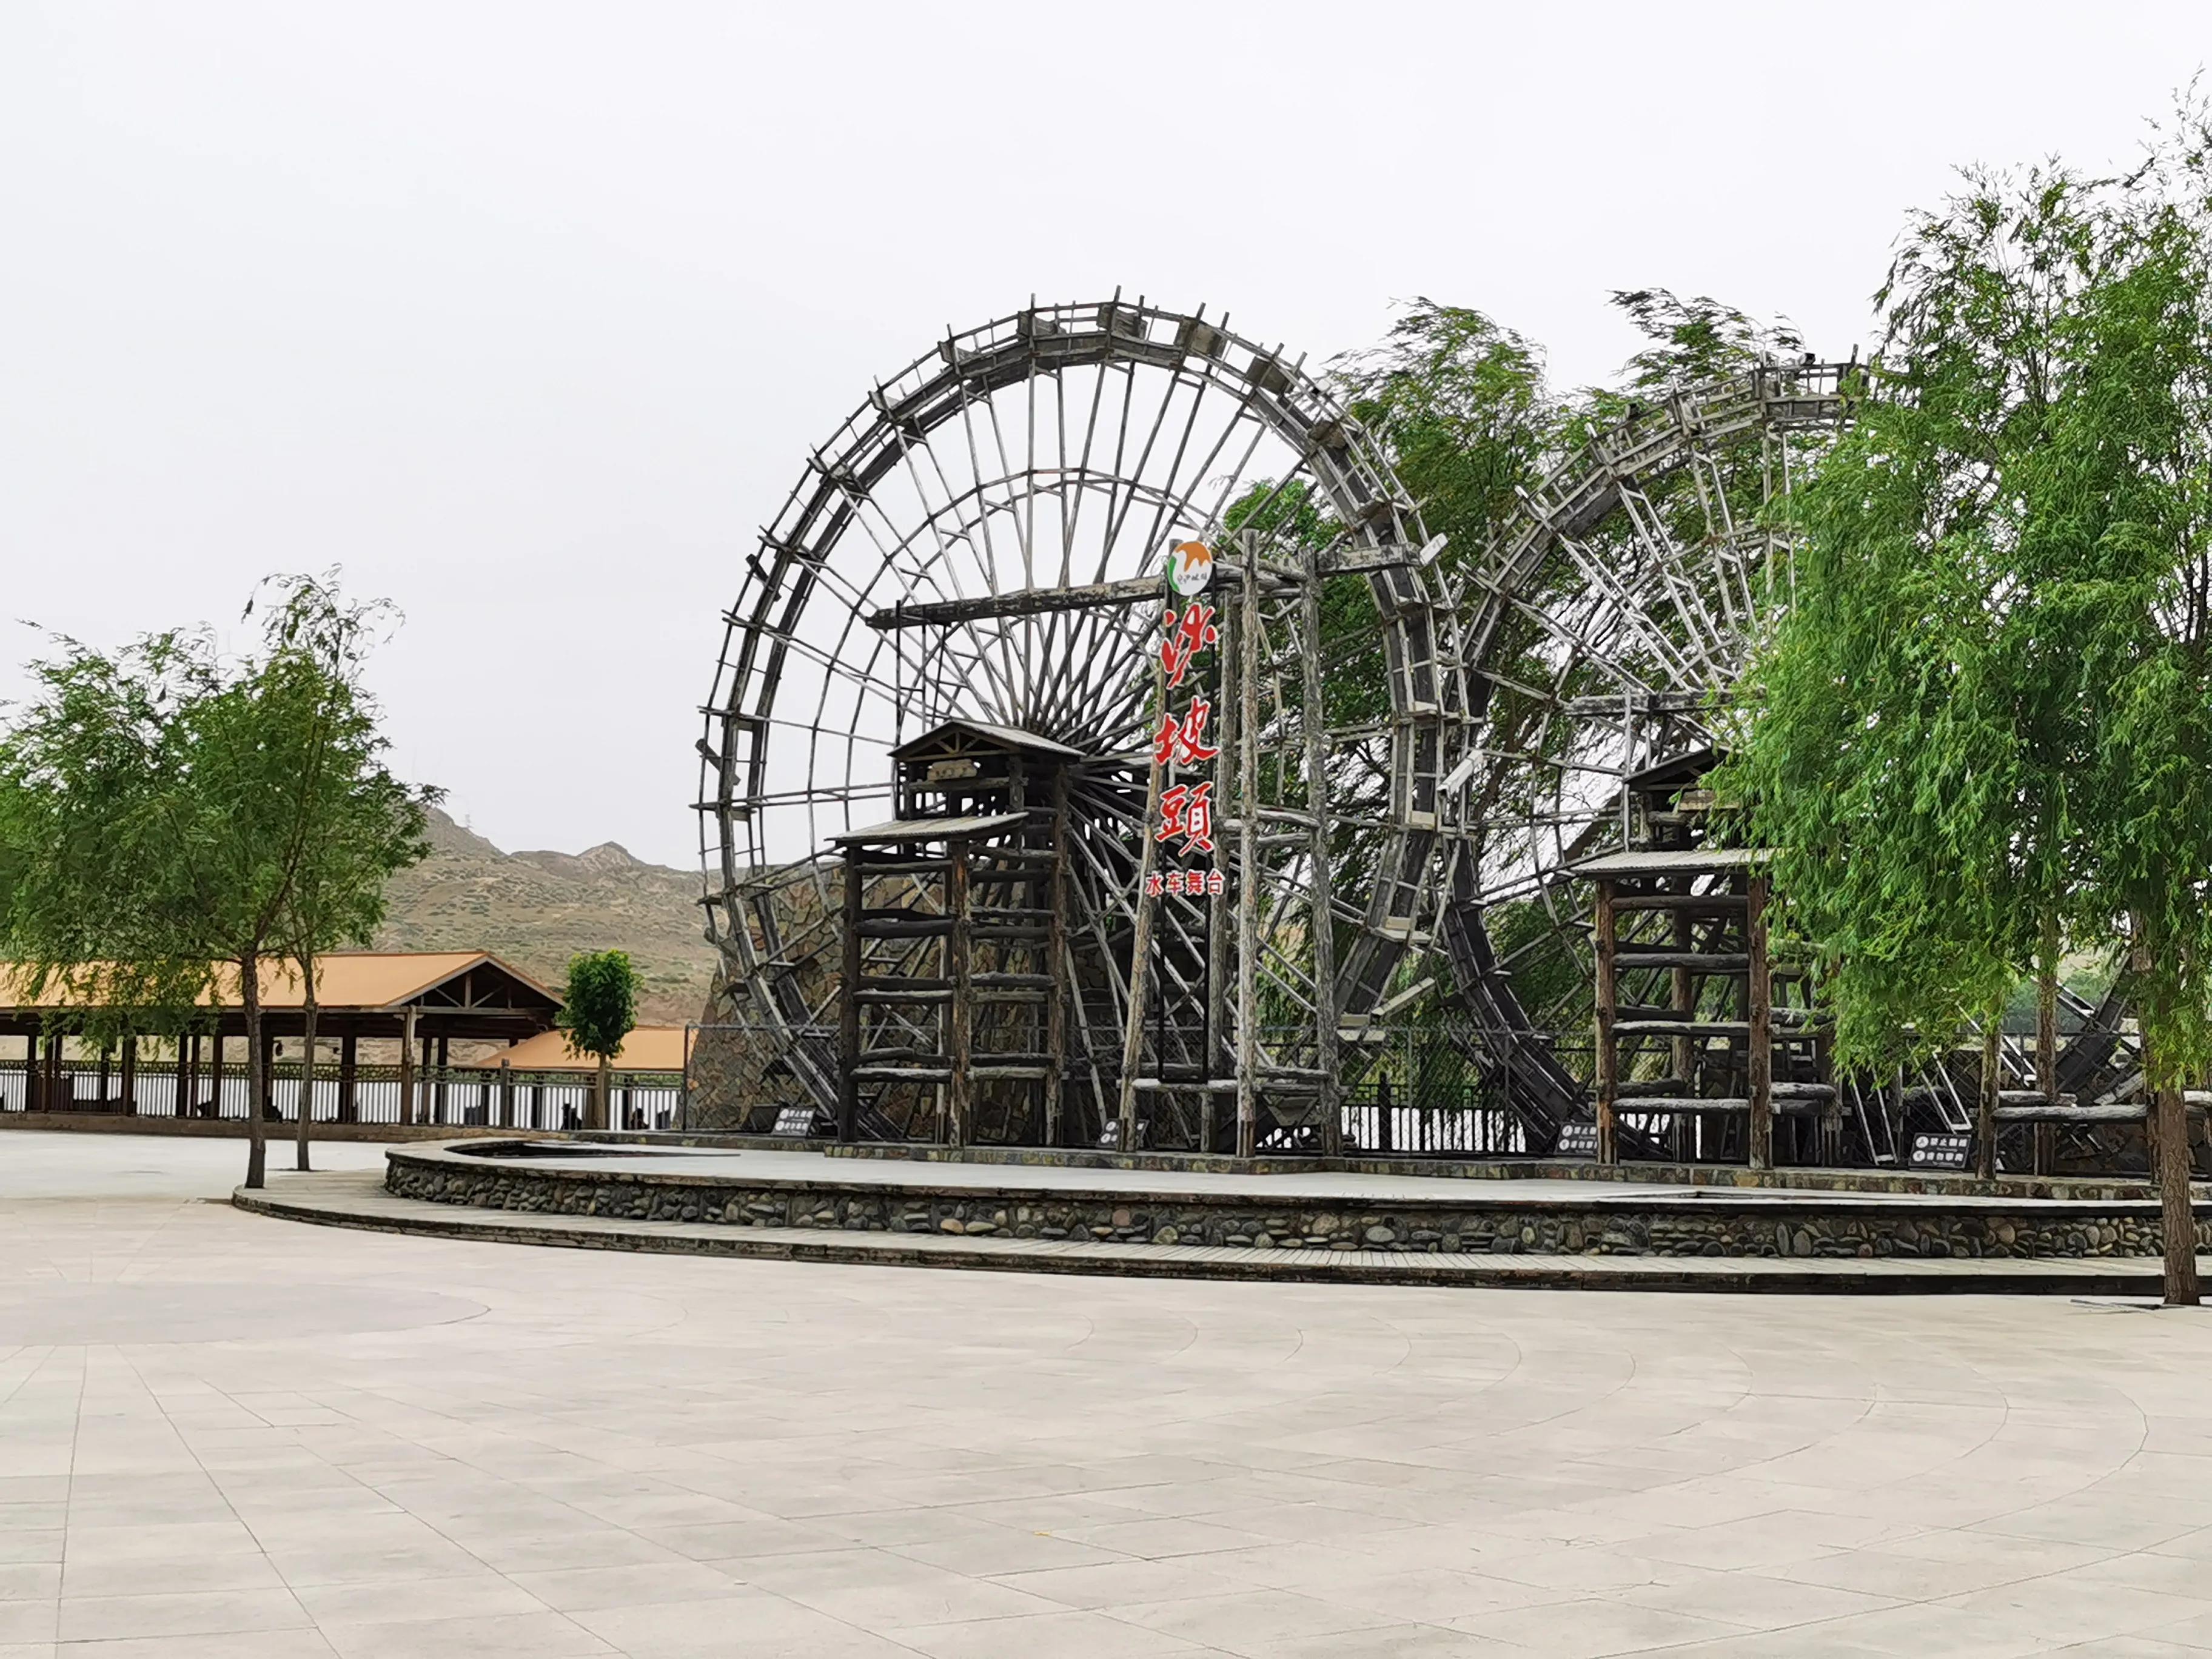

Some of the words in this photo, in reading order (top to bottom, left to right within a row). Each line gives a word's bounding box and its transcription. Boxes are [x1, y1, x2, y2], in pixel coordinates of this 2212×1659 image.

[1155, 603, 1218, 856] 沙坡頭
[1145, 868, 1225, 897] 水车舞台
